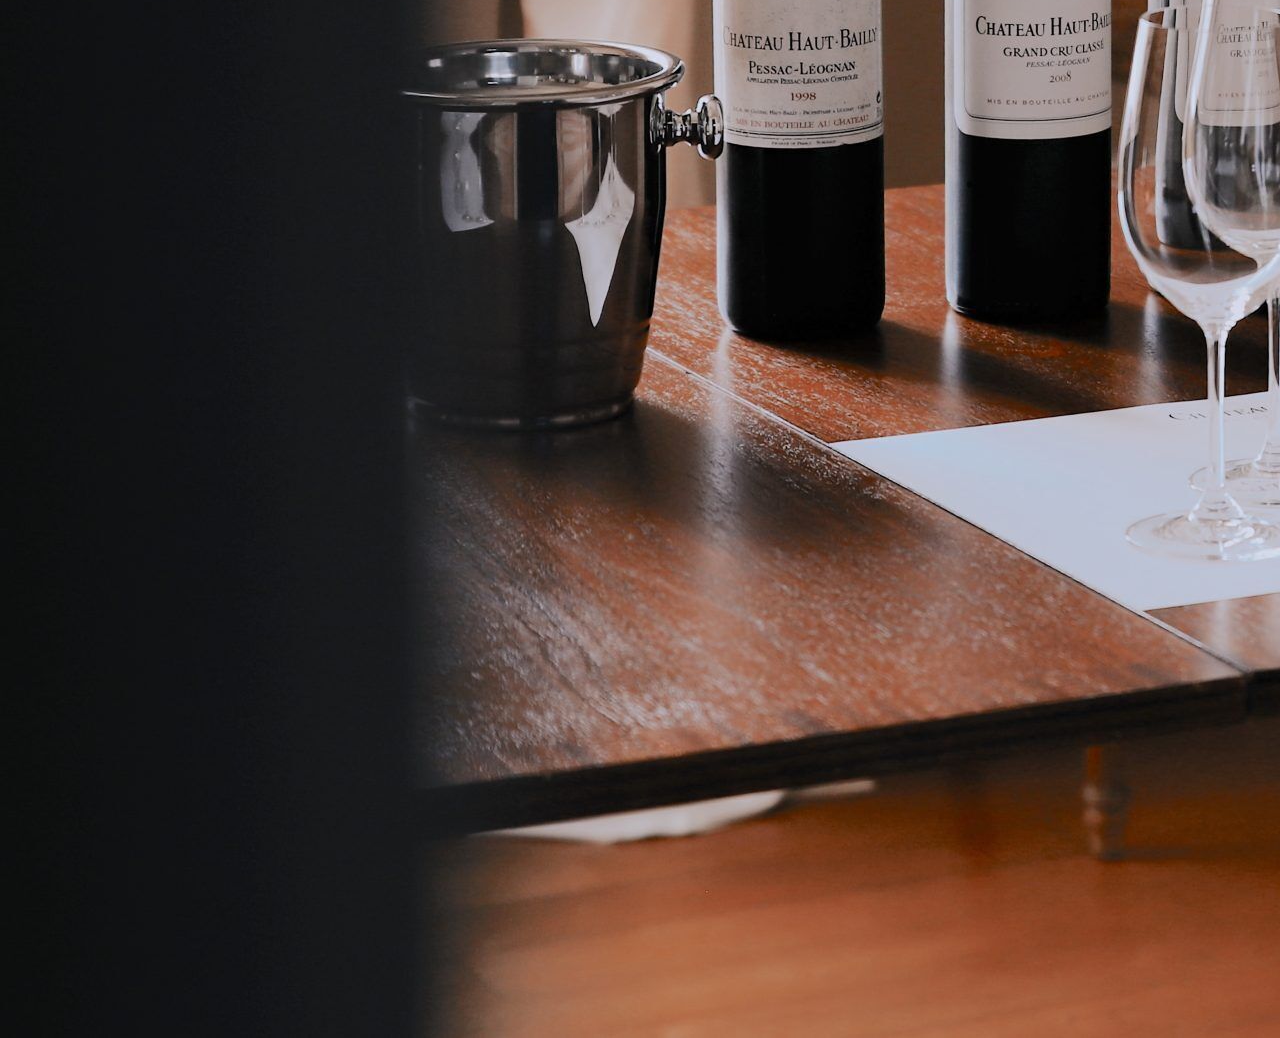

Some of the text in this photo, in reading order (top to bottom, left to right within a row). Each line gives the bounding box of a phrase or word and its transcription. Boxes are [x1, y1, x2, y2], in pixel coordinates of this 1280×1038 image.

[975, 15, 1046, 37] CHATEAU
[723, 25, 784, 51] CHATEAU
[1002, 46, 1048, 58] GRAND
[1050, 45, 1074, 57] CRU
[749, 60, 857, 75] PESSAC-LÉOGNAN
[1049, 71, 1072, 83] 2008
[791, 92, 817, 101] 1998
[1022, 98, 1071, 106] BOUTEILLE
[750, 119, 762, 128] EN
[764, 120, 815, 129] BOUTEILLE
[817, 119, 831, 129] AU
